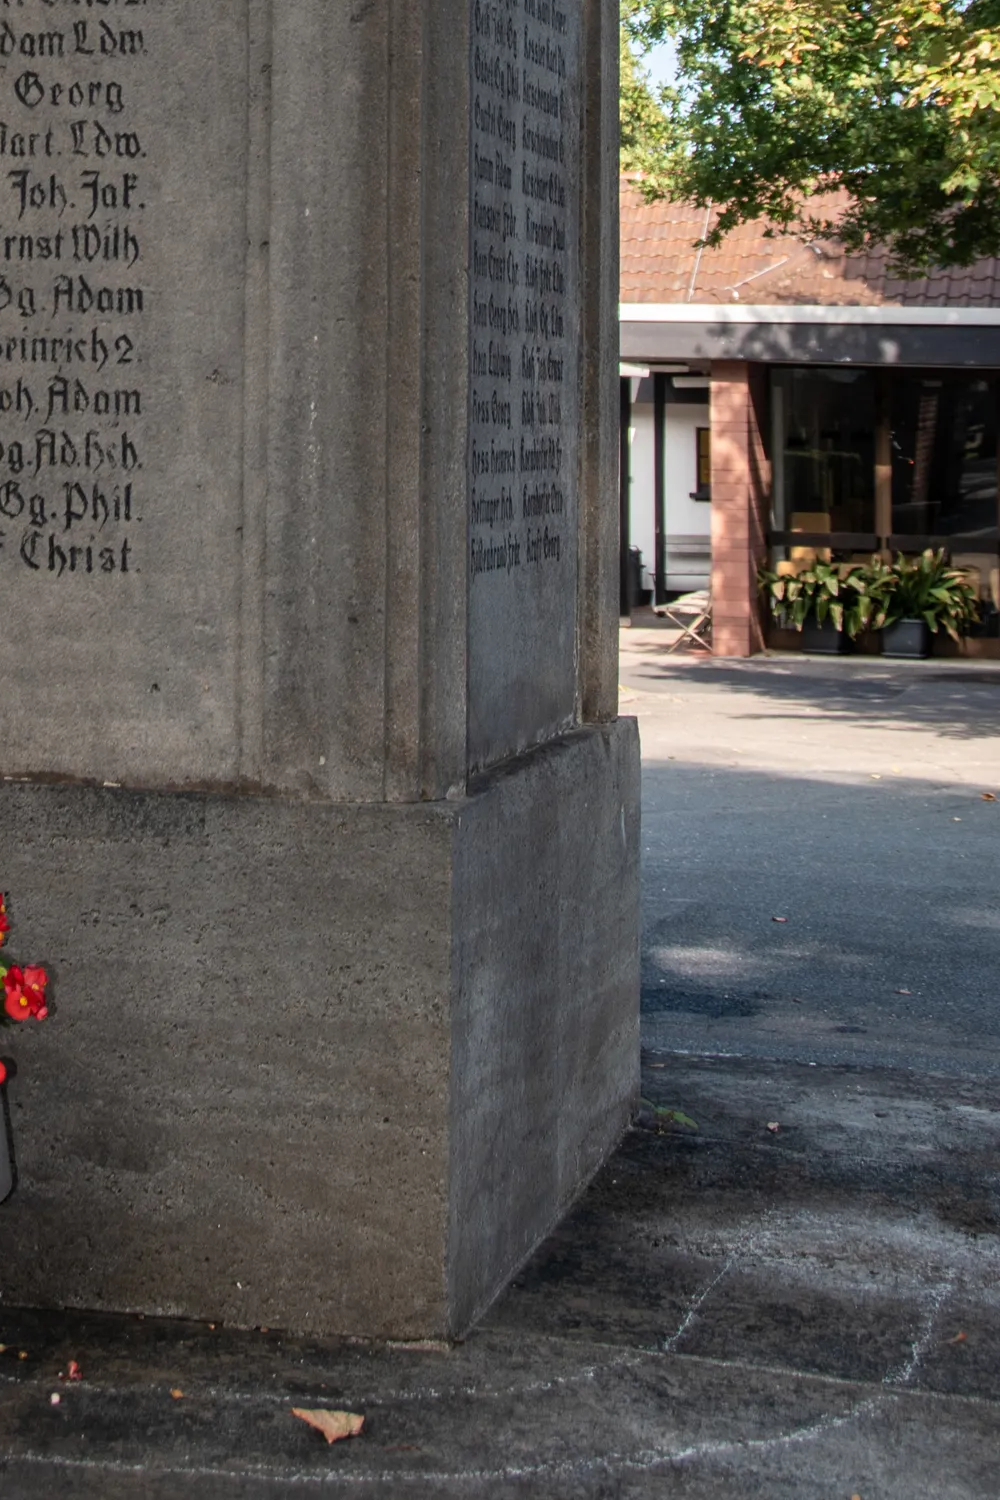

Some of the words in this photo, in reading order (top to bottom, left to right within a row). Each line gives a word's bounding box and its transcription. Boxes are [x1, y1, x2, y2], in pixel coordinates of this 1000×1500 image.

[14, 70, 124, 113] Georg
[53, 273, 144, 319] Adam
[43, 371, 141, 425] Adam
